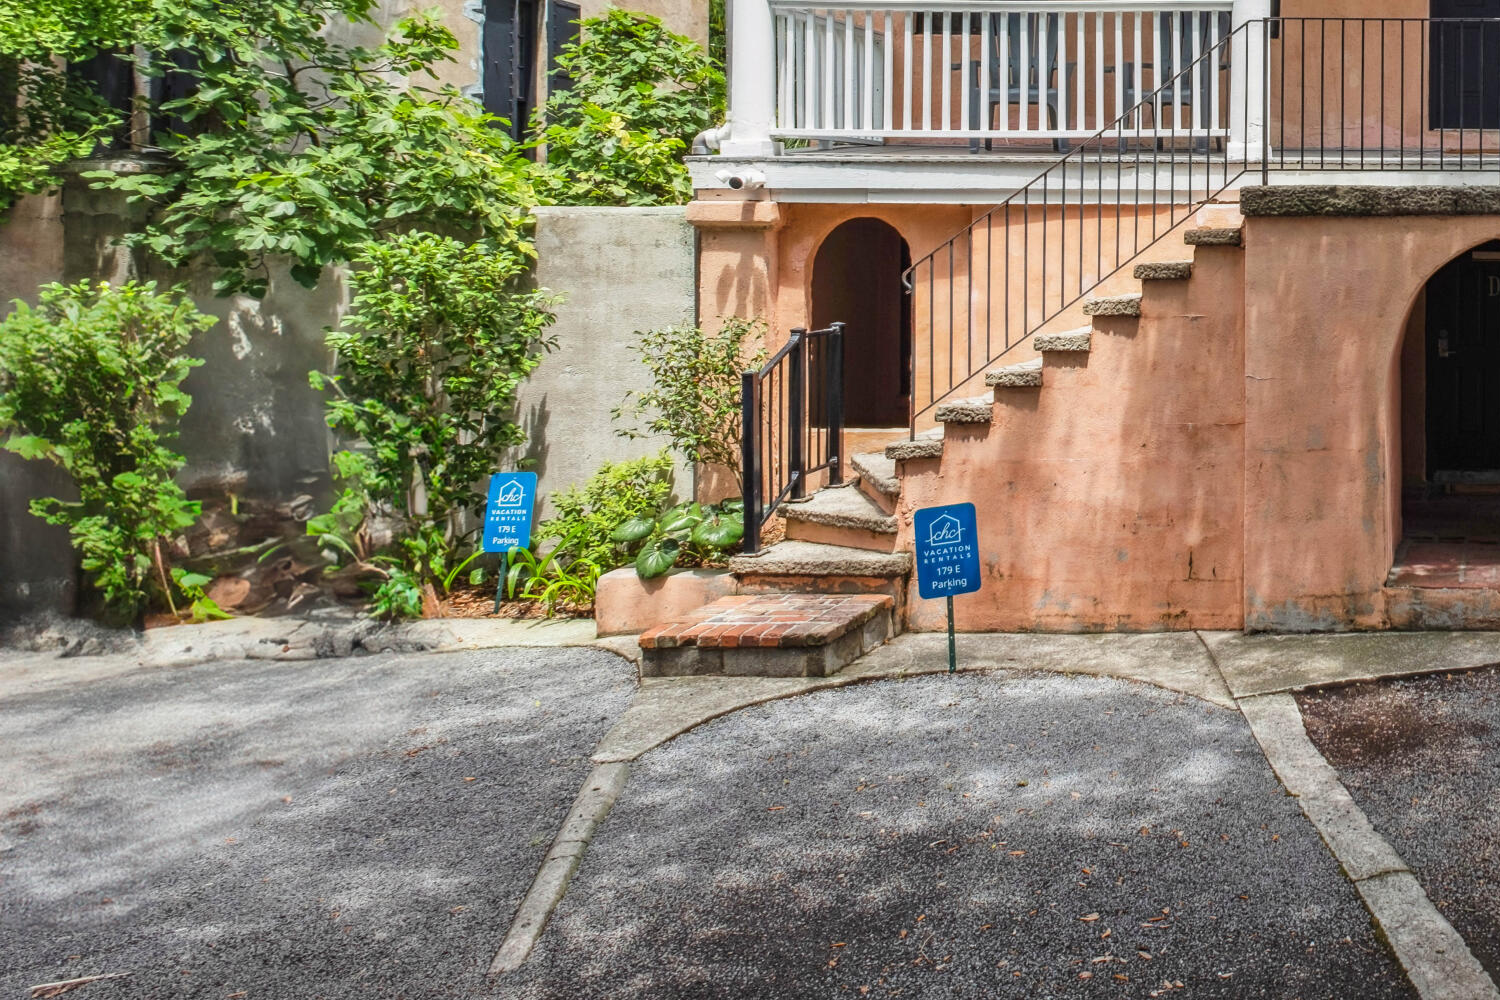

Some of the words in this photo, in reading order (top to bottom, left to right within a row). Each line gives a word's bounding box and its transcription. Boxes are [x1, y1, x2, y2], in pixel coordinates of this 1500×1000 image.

[1488, 275, 1500, 297] D
[498, 525, 511, 533] 179
[511, 525, 516, 533] E
[492, 537, 519, 545] Parking
[923, 544, 971, 557] VACATION
[924, 552, 972, 564] RENTALS
[937, 565, 953, 576] 179
[955, 564, 961, 573] E
[932, 578, 967, 590] Parking
